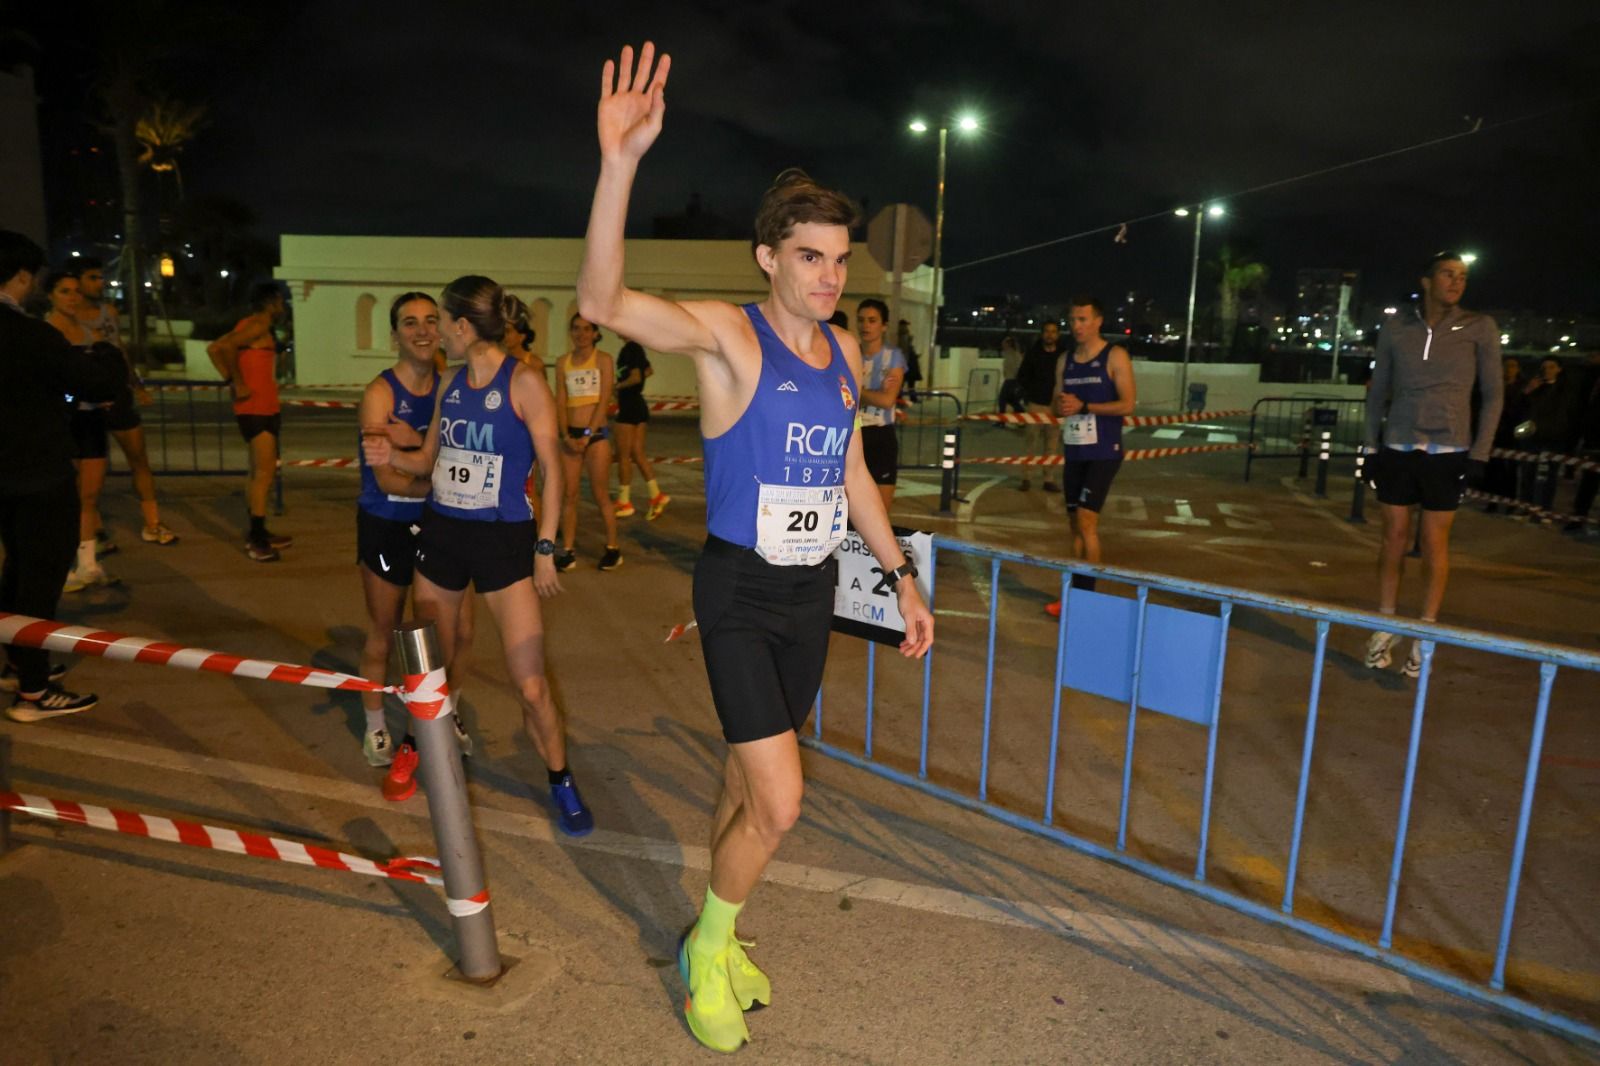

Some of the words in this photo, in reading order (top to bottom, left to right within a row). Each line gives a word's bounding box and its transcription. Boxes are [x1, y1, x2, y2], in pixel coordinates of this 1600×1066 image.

[440, 417, 495, 452] RCM
[785, 422, 848, 456] RCM
[448, 465, 470, 484] 19
[786, 510, 819, 532] 20
[795, 544, 824, 554] mayoral
[850, 577, 862, 591] A
[852, 601, 885, 622] RCM
